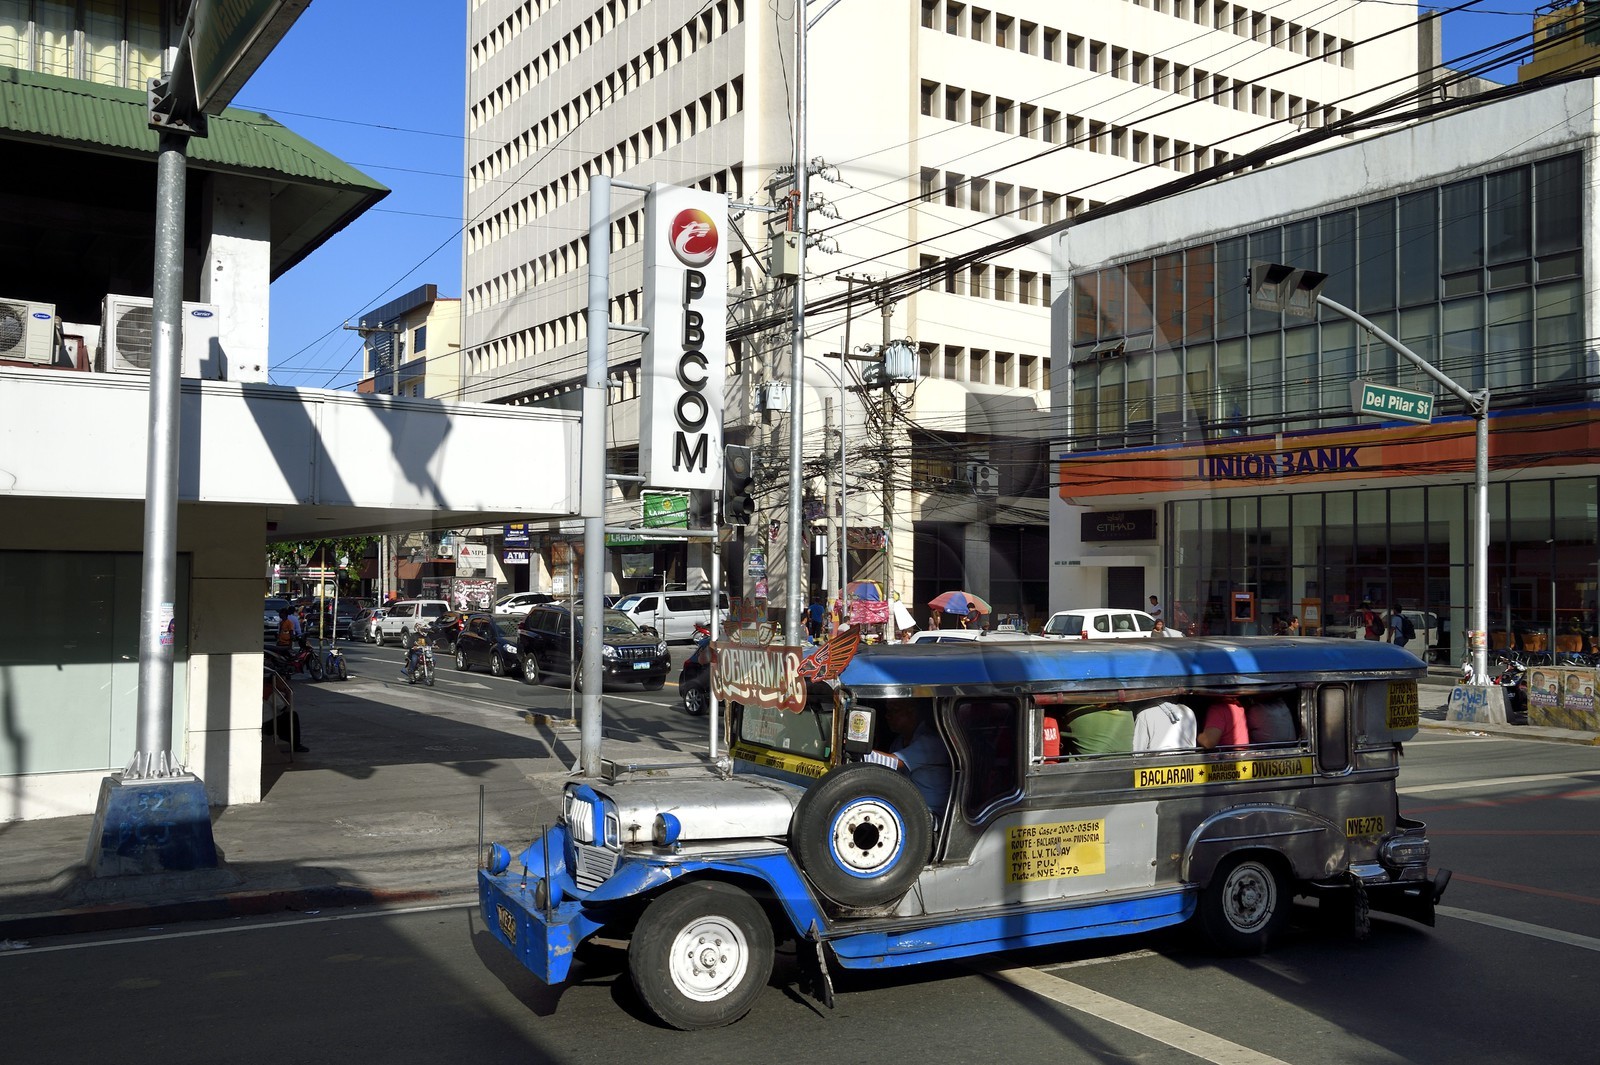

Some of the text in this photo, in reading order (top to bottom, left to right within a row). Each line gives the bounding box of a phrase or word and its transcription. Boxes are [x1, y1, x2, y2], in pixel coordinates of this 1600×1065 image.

[671, 269, 709, 474] PBCOM
[1366, 391, 1429, 415] Del Pilar St
[1199, 447, 1360, 482] UNIONBANK
[1097, 523, 1135, 532] ETIHAD
[507, 551, 525, 559] ATM
[1140, 767, 1194, 787] BACLARAN
[1208, 770, 1241, 781] HARRISON
[1252, 760, 1303, 779] DIVISORIA
[1011, 828, 1037, 839] LTFRB
[1058, 822, 1100, 835] 2003-03518
[1347, 817, 1383, 835] NYE-278
[1073, 833, 1100, 844] DIVISORIA
[1011, 859, 1057, 872] TYPE PUJ
